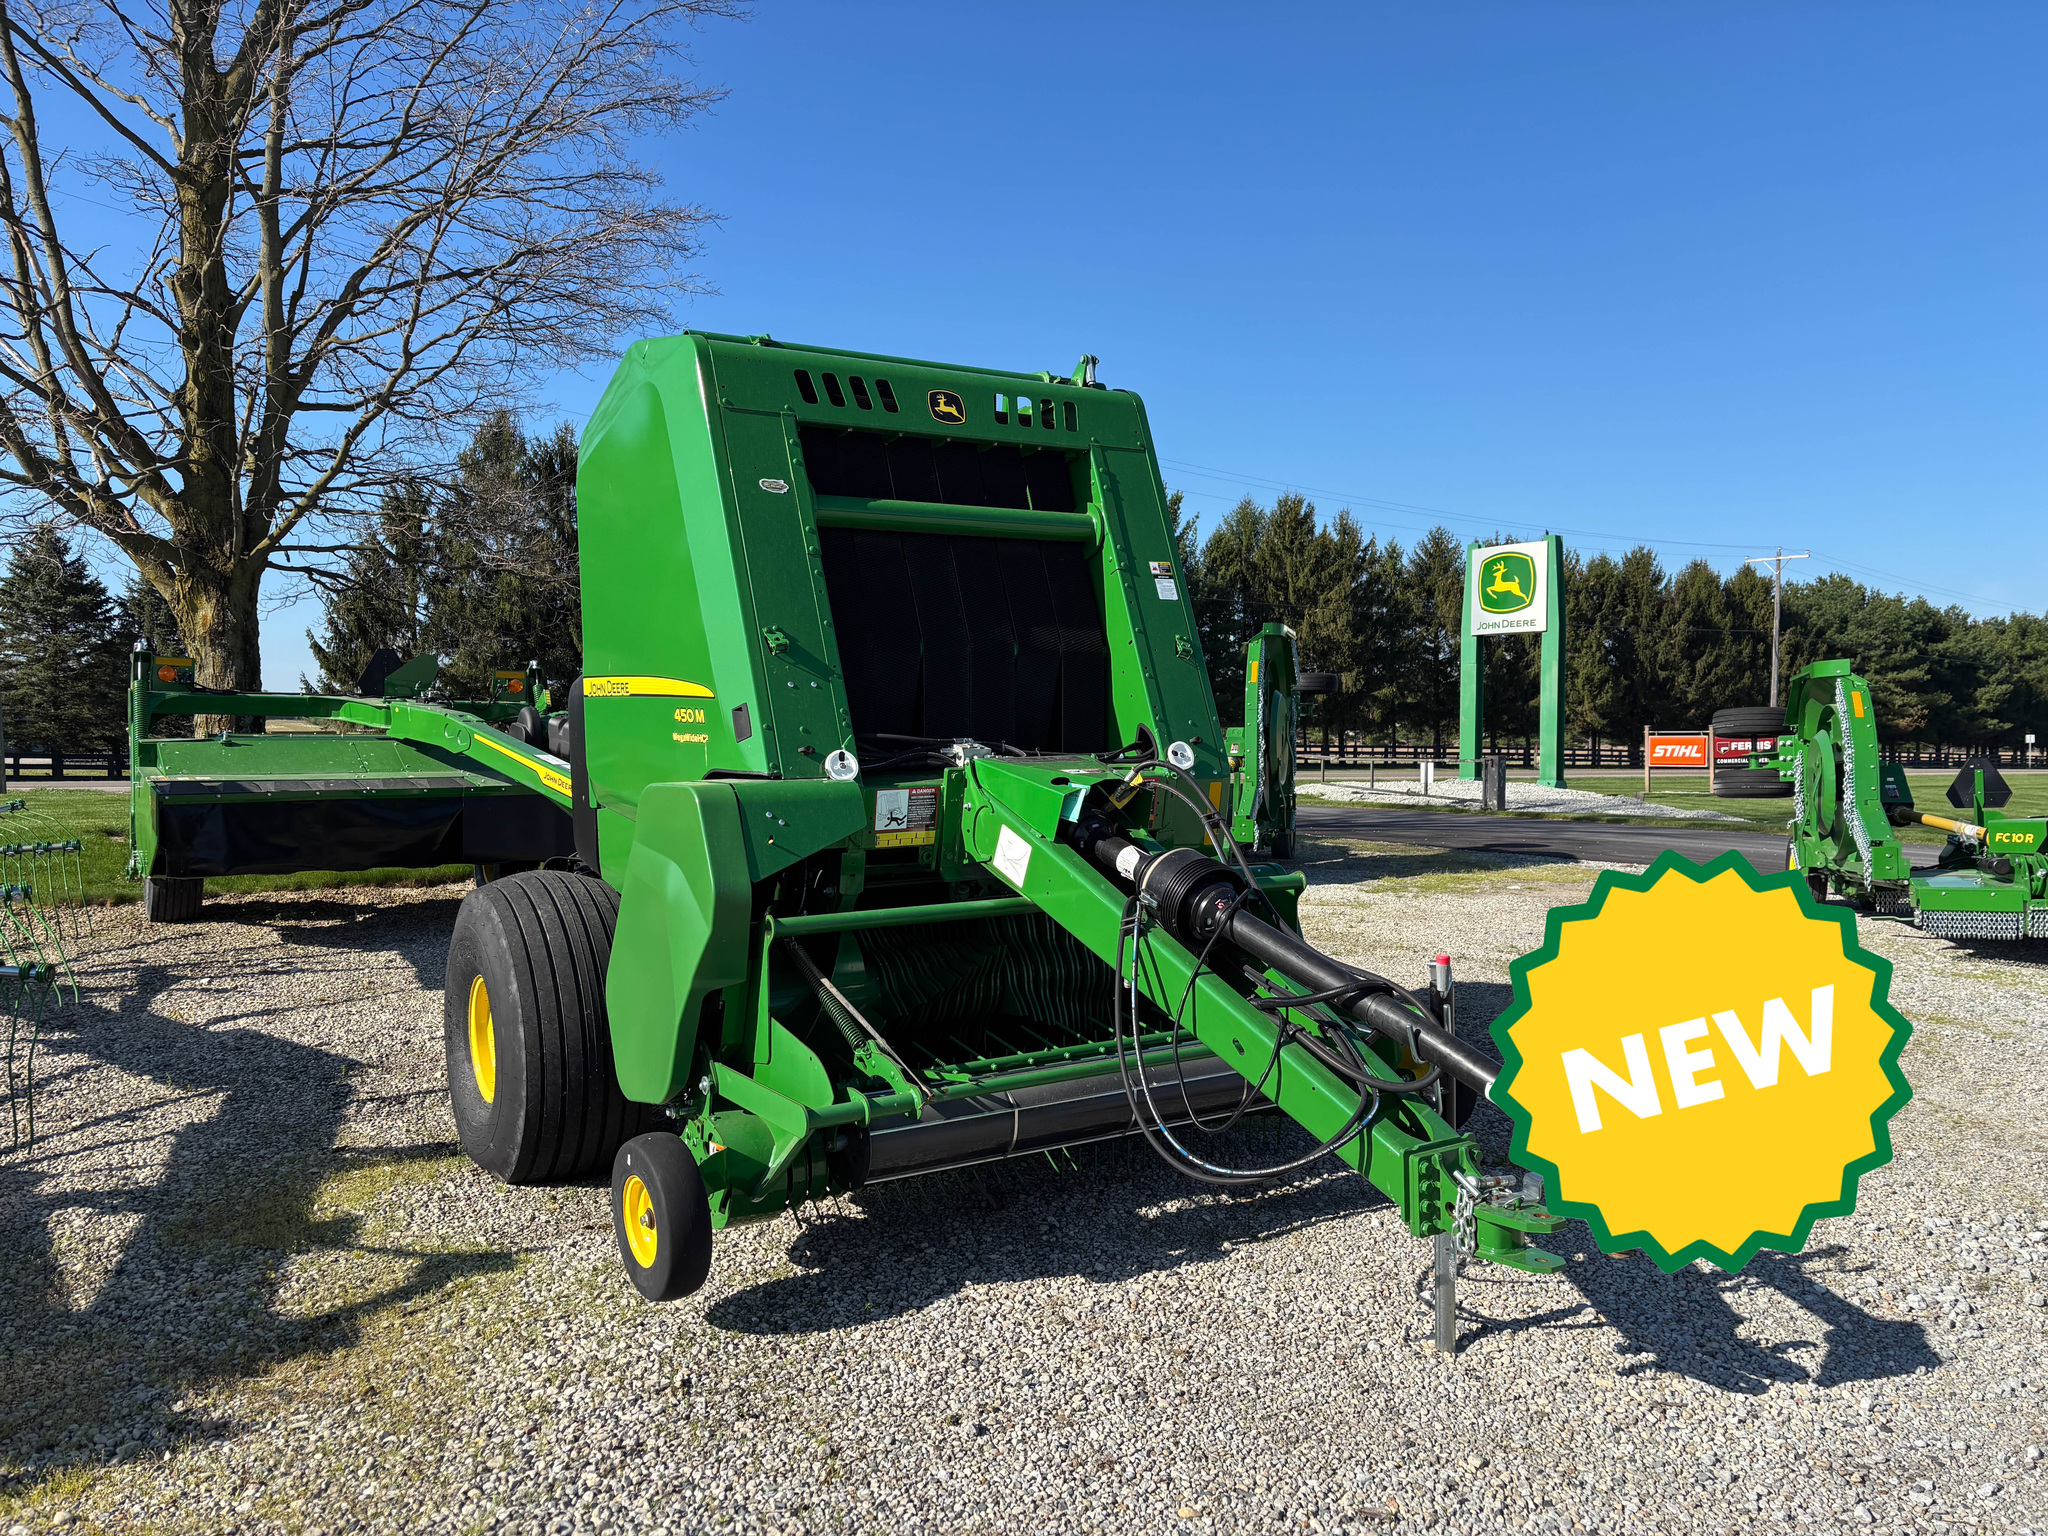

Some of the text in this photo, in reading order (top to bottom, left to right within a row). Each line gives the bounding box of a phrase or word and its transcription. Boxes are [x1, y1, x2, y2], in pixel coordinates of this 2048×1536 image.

[1477, 619, 1537, 630] JOHN DEERE
[588, 680, 630, 695] JOHN DEERE
[674, 708, 695, 723] 450
[1652, 745, 1702, 757] STIHL
[544, 772, 572, 790] JOHN DEER
